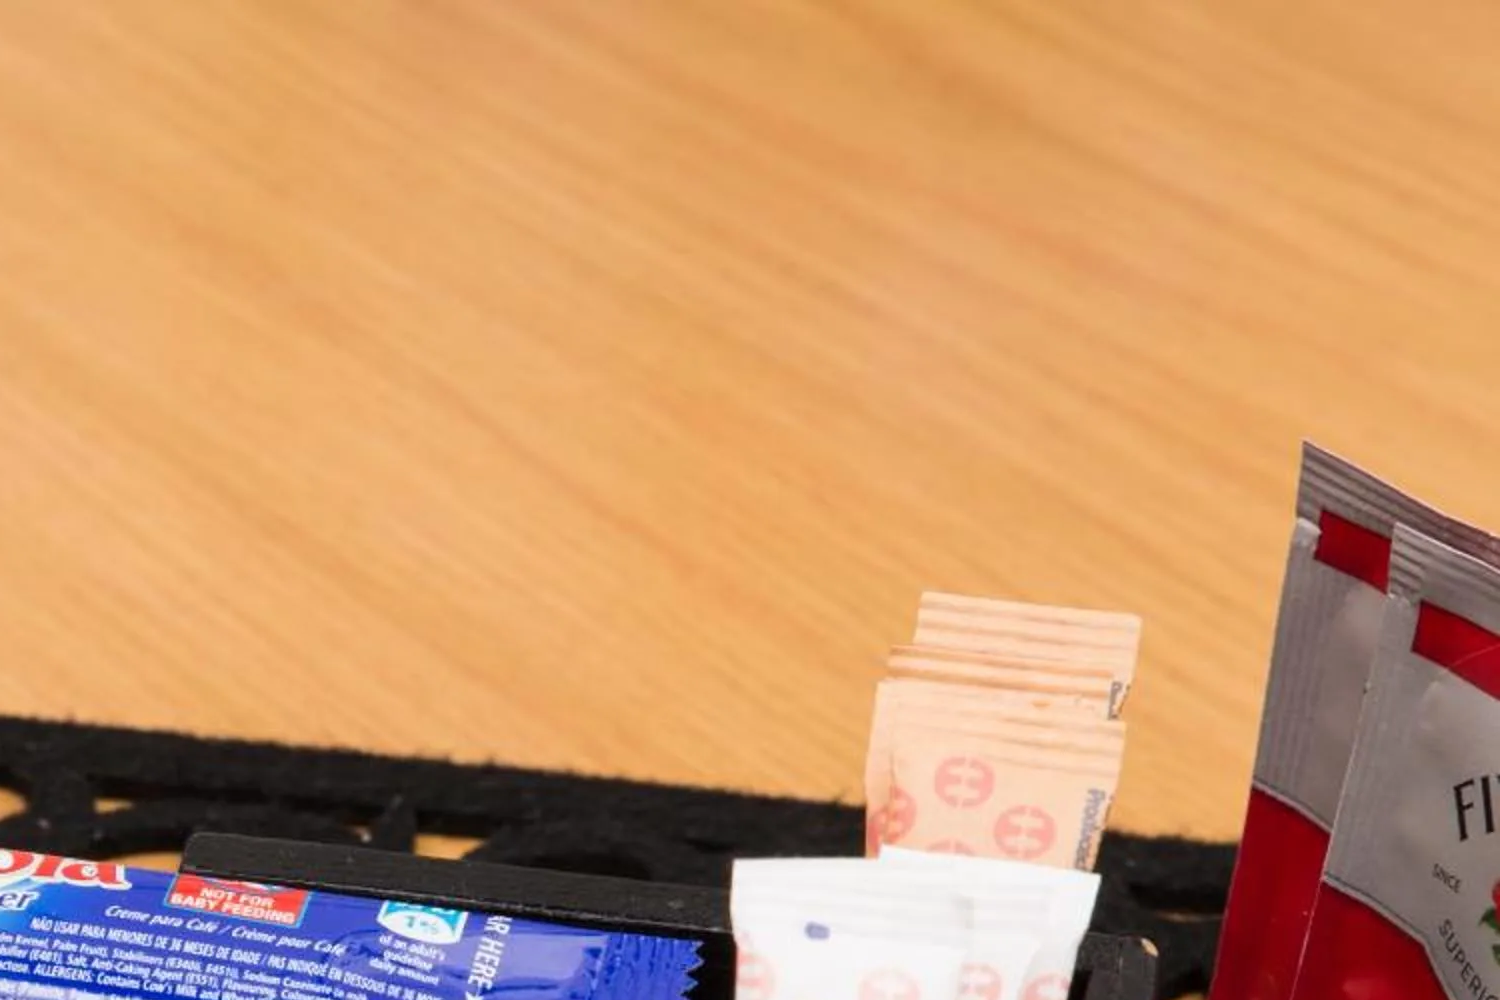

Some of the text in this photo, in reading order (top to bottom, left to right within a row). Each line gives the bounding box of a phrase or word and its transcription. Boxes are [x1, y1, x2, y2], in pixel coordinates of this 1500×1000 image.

[1453, 774, 1500, 842] FI
[1431, 863, 1463, 893] SINCE
[169, 892, 296, 924] BABY FEEDING
[200, 886, 275, 908] NOT FOR
[467, 935, 506, 990] HERE
